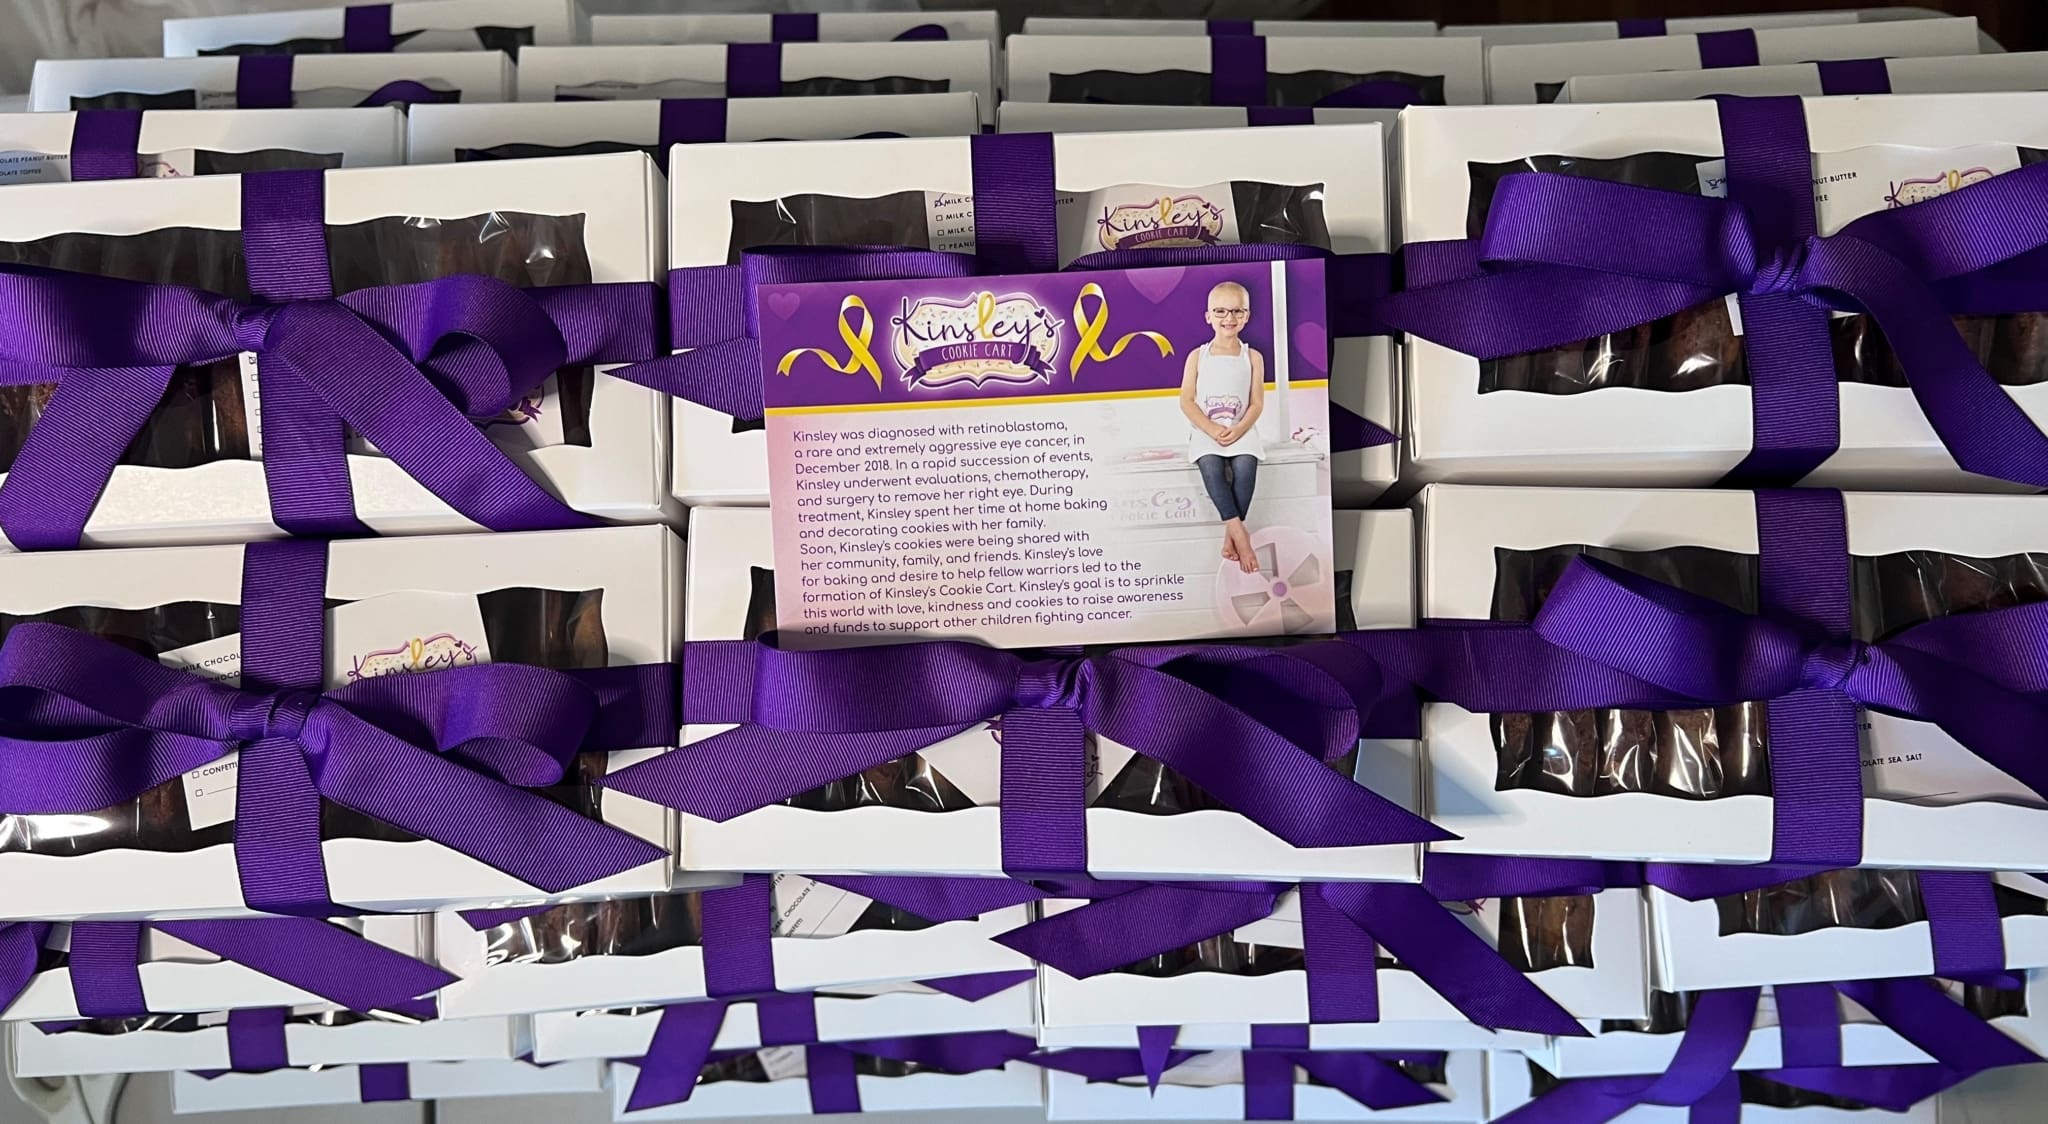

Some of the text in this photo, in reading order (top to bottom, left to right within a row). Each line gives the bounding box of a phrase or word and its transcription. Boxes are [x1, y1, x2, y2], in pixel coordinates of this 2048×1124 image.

[1811, 172, 1857, 185] NUT BUTTER
[944, 198, 962, 206] MILK
[946, 212, 965, 220] MILK
[1097, 196, 1225, 239] Kinsley's
[947, 227, 966, 235] MILK
[948, 241, 975, 250] PEANU
[891, 290, 1066, 363] Kinsley's
[941, 343, 1014, 361] COOKIE CART
[793, 420, 1068, 444] Kinsley was diagnosed with retinoblastoma,
[794, 434, 1085, 459] a rare and extremely aggressive eye cancer, in
[795, 450, 1093, 475] December 2018. In a rapid succession of events,
[796, 468, 1089, 492] Kinsley underwent evaluations, chemotherapy,
[797, 483, 1074, 508] and surgery to remove her right eye. During
[798, 509, 865, 523] treatment,
[867, 507, 912, 521] Kinsley
[914, 505, 950, 521] spent
[953, 504, 975, 516] her
[977, 503, 1006, 515] time
[1008, 502, 1022, 513] at
[1024, 500, 1061, 513] home
[1063, 497, 1108, 512] baking
[799, 516, 1046, 539] and decorating cookies with her family.
[799, 530, 1090, 556] Soon, Kinsley's cookies were being shared with
[800, 546, 1104, 571] her community, family, and friends. Kinsley's love
[801, 559, 1142, 587] for baking and desire to help fellow warriors led to the
[802, 573, 1185, 604] formation of Kinsley's Cookie Cart. Kinsley's goal is to sprinkle
[803, 591, 1184, 619] this world with love, kindness and cookies to raise awareness
[804, 610, 1133, 635] and funds to support other children fighting cancer.
[204, 652, 241, 668] CHOCOL
[202, 761, 238, 777] CONFETTI
[1862, 753, 1922, 768] OLATE SEA SALT
